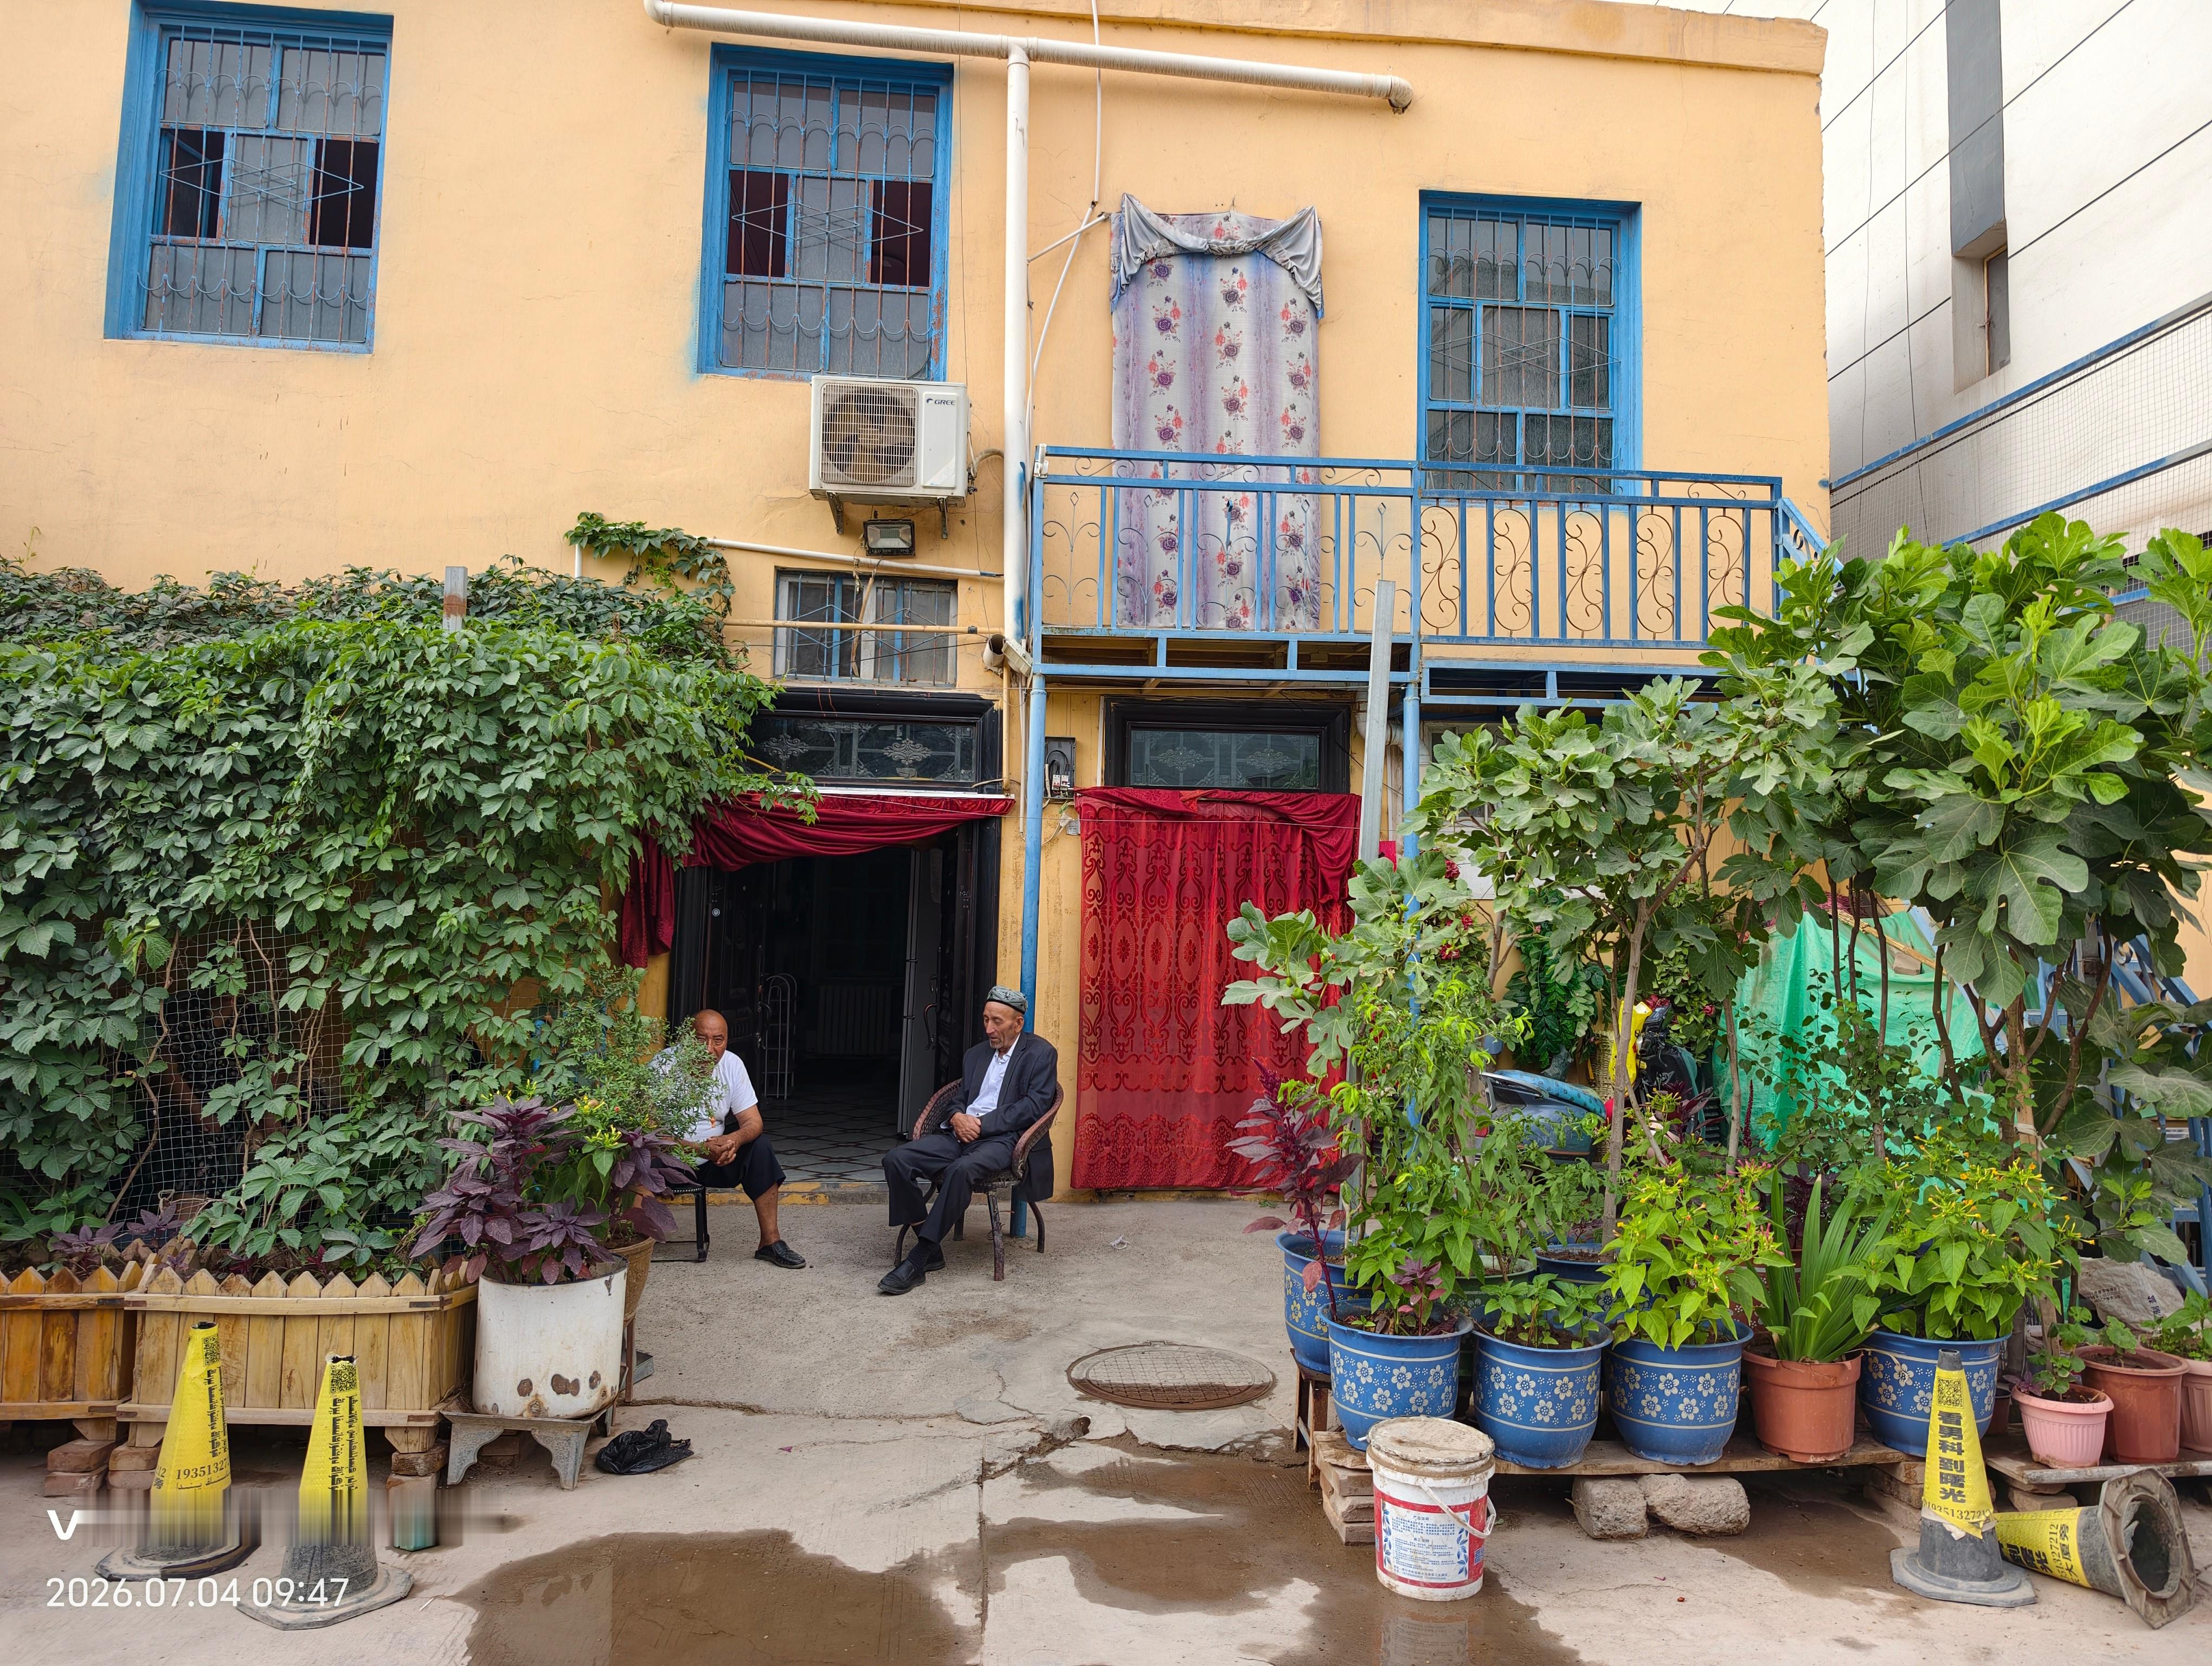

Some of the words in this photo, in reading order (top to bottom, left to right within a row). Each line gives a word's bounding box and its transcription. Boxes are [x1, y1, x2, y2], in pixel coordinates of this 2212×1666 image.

[1937, 1410, 1966, 1504] 看男科到曙光
[156, 1466, 166, 1478] 12
[176, 1458, 229, 1480] 19351327
